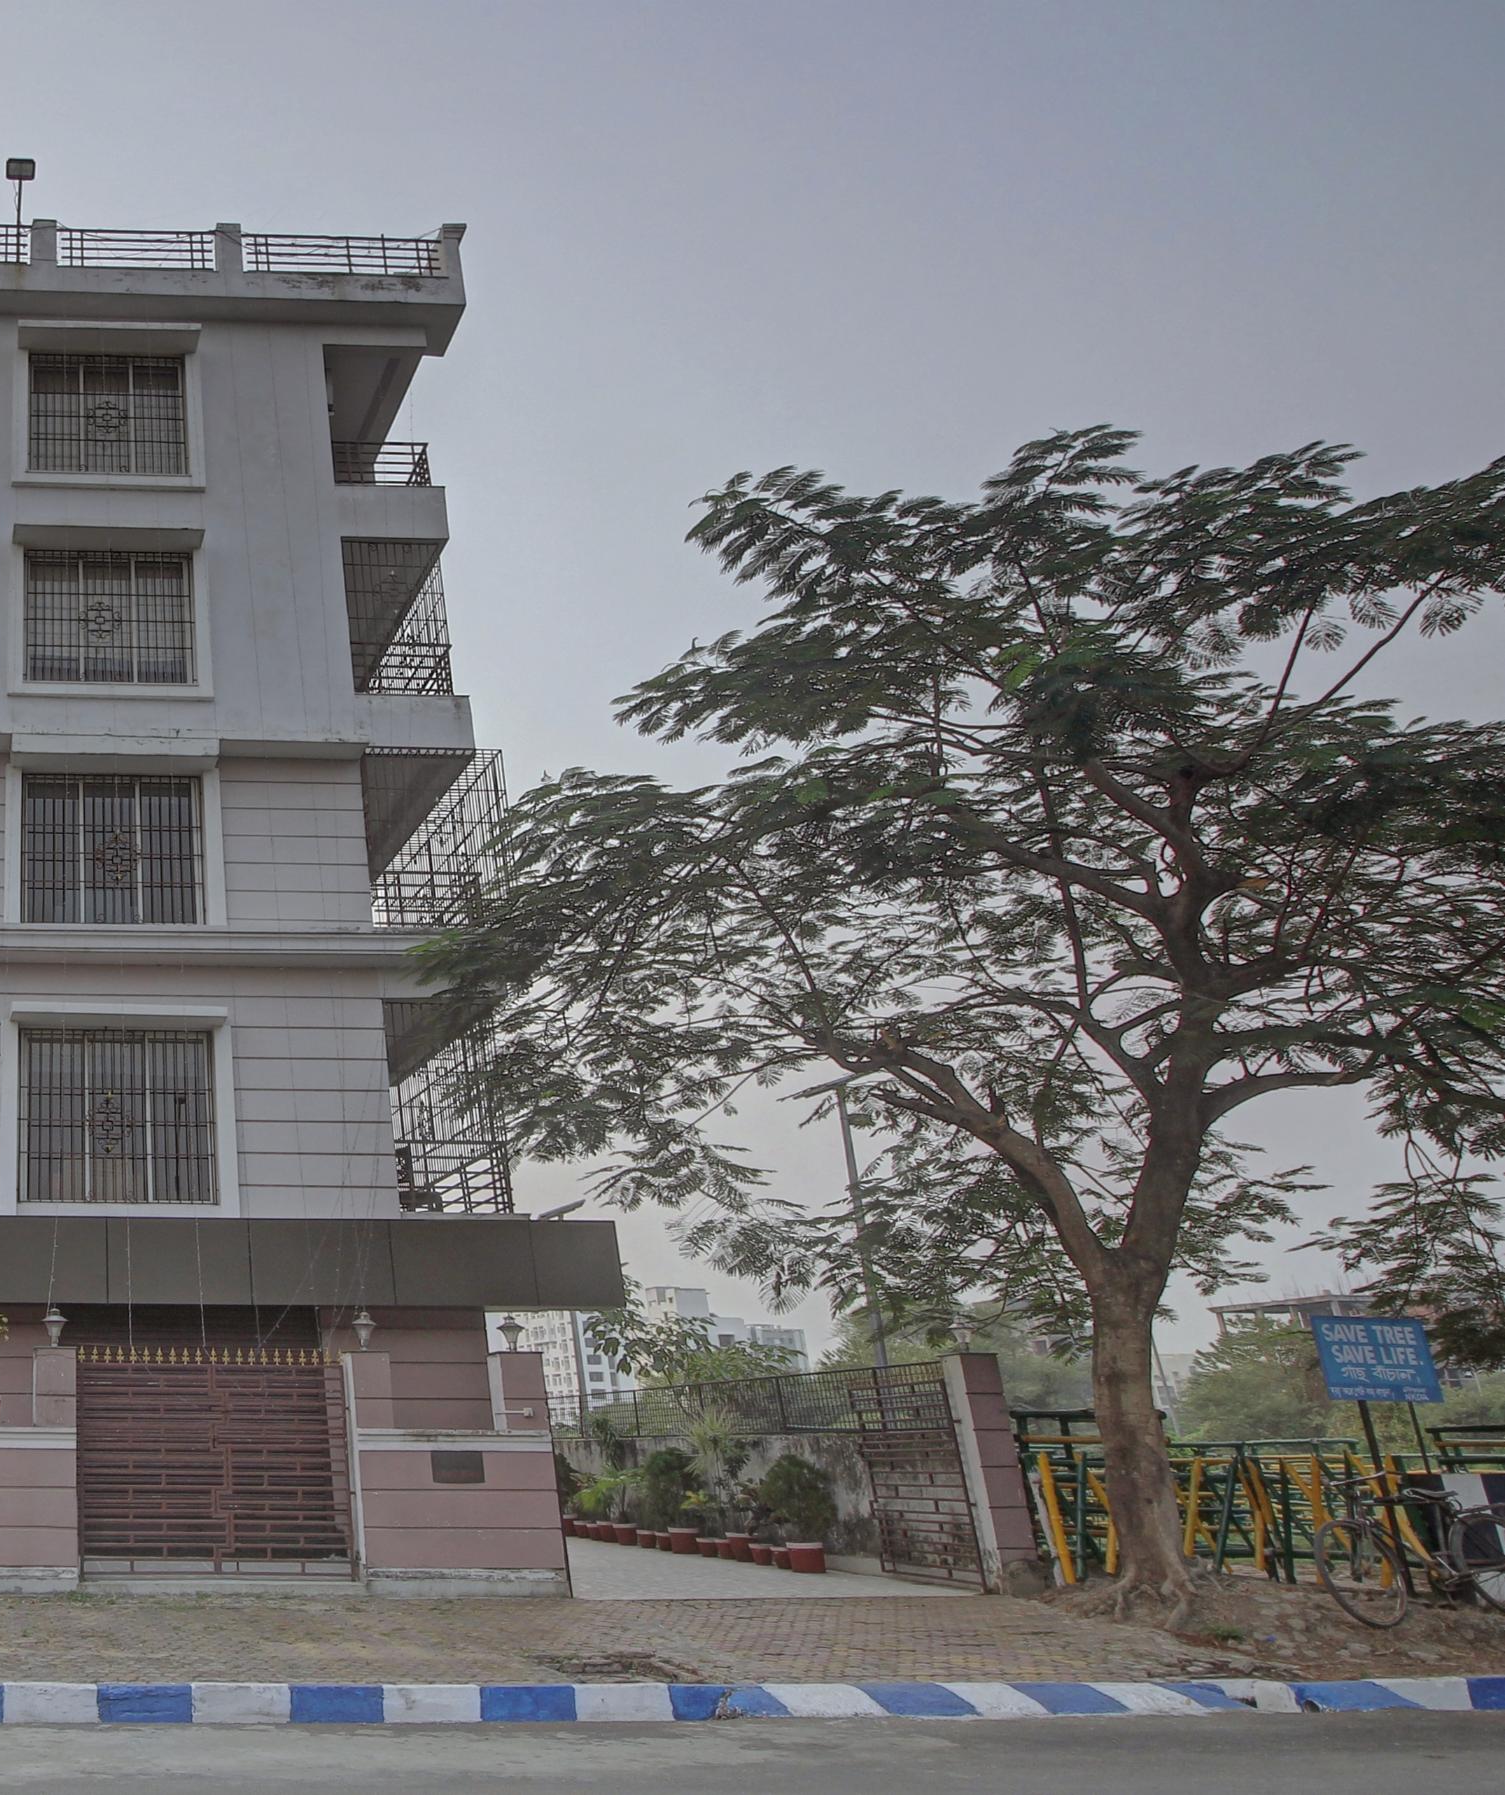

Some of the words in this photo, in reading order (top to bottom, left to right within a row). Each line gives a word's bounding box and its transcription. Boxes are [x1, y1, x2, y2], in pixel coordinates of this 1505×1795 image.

[1321, 1324, 1368, 1343] SAVE
[1371, 1325, 1417, 1345] TREE
[1331, 1345, 1377, 1364] SAVE
[1380, 1346, 1424, 1366] LIFE.
